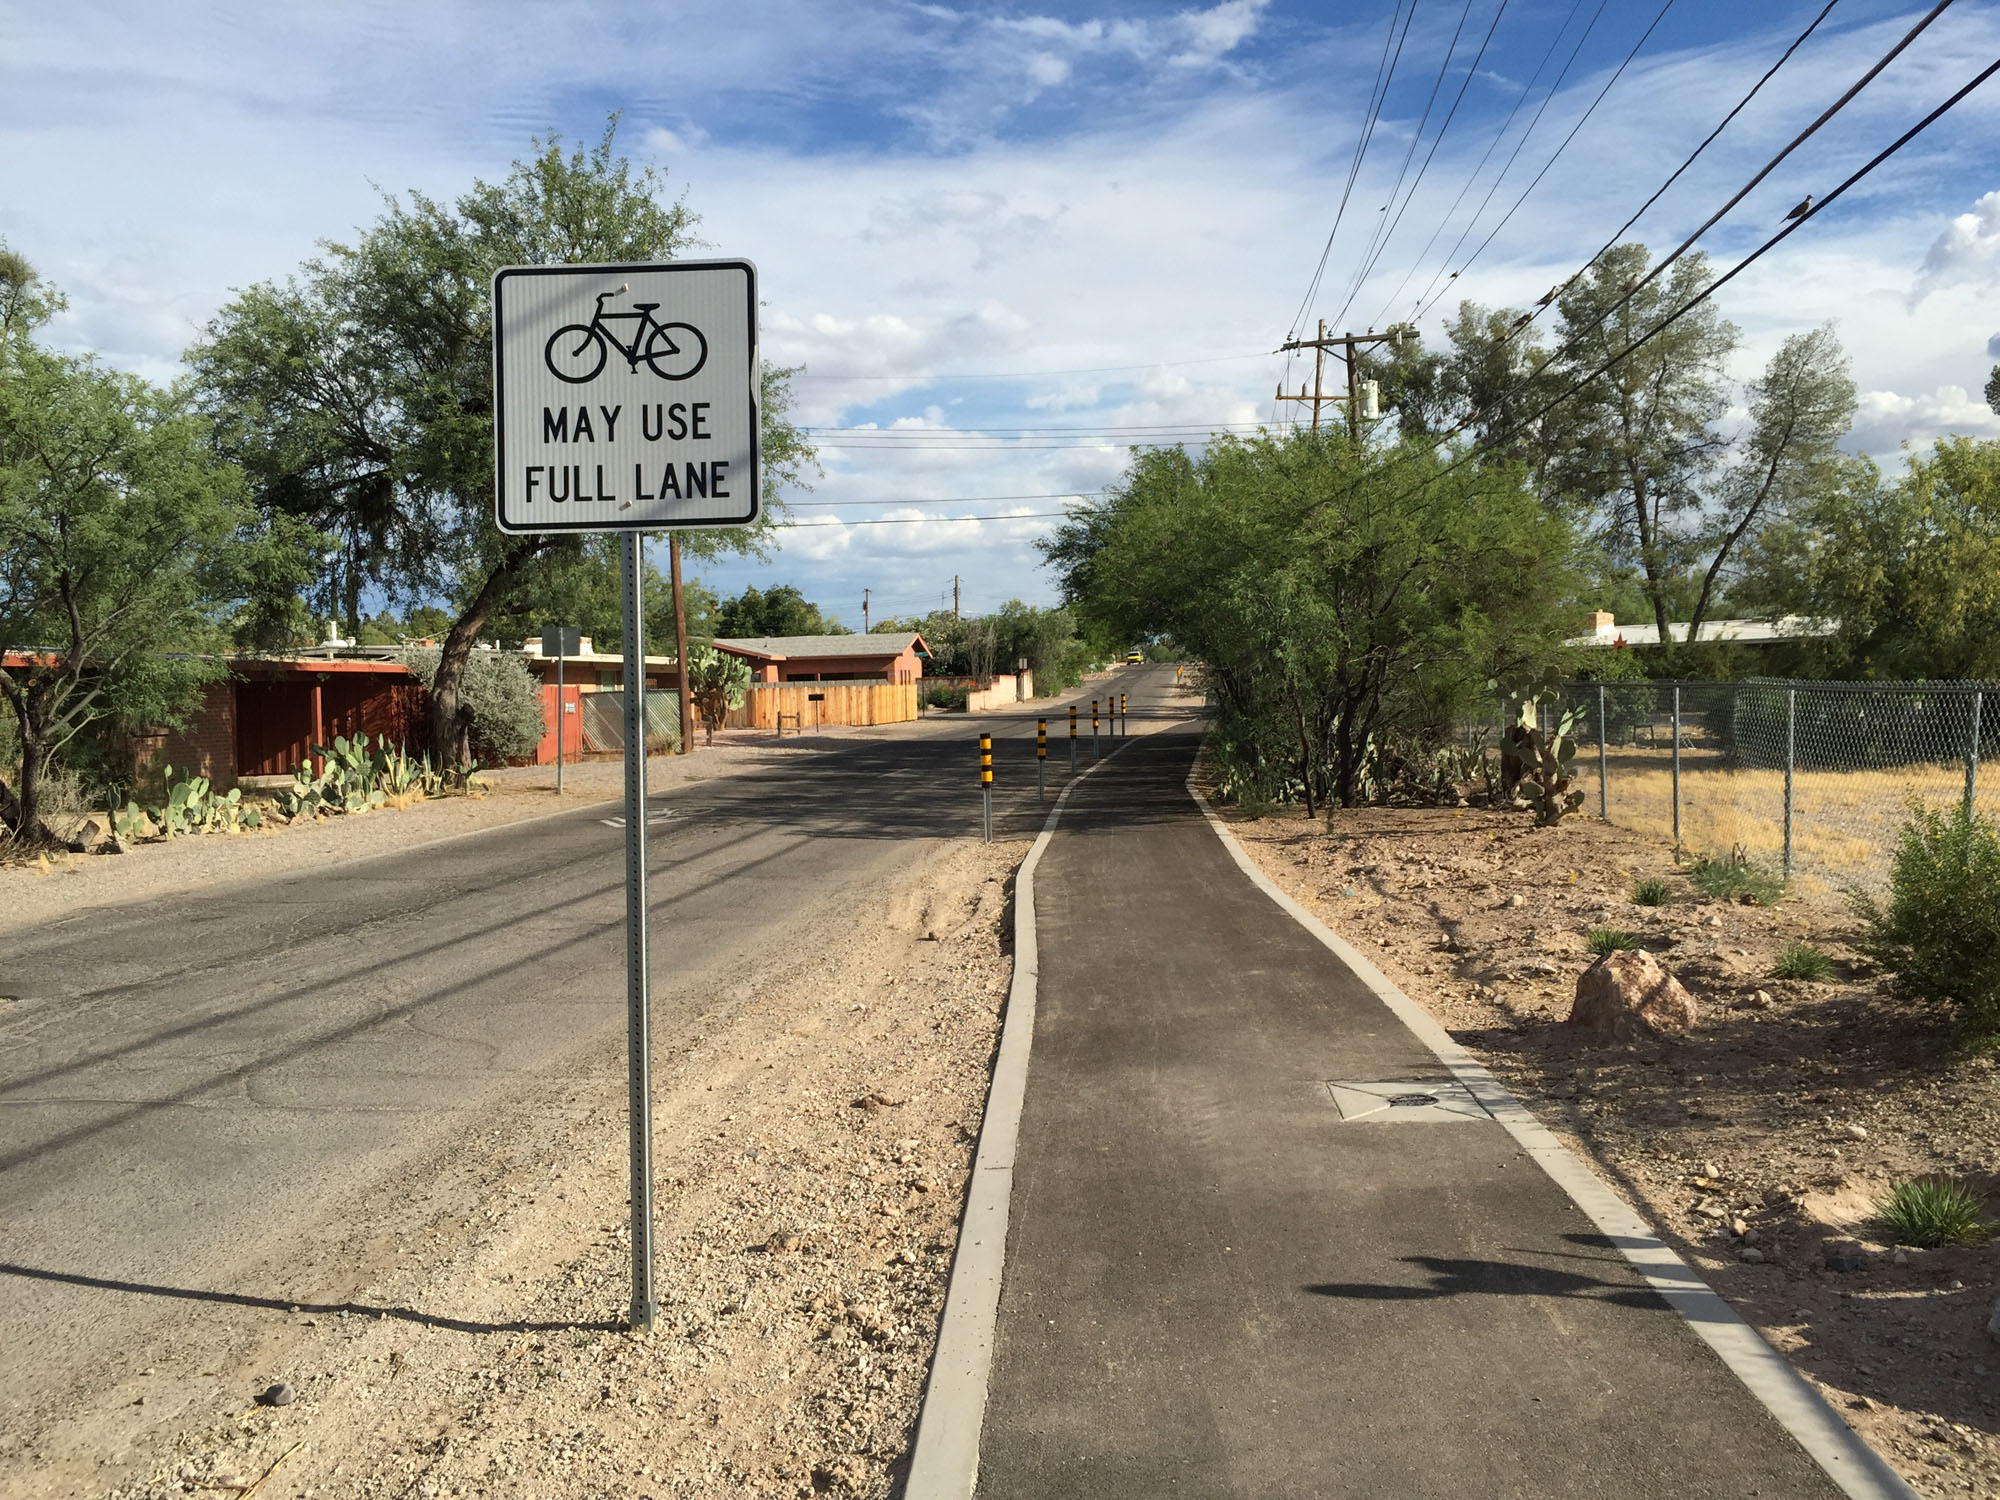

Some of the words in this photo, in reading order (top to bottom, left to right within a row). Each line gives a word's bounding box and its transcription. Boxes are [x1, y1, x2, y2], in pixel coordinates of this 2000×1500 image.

[543, 405, 622, 444] MAY
[642, 402, 711, 442] USE
[525, 465, 616, 503] FULL
[635, 461, 730, 500] LANE
